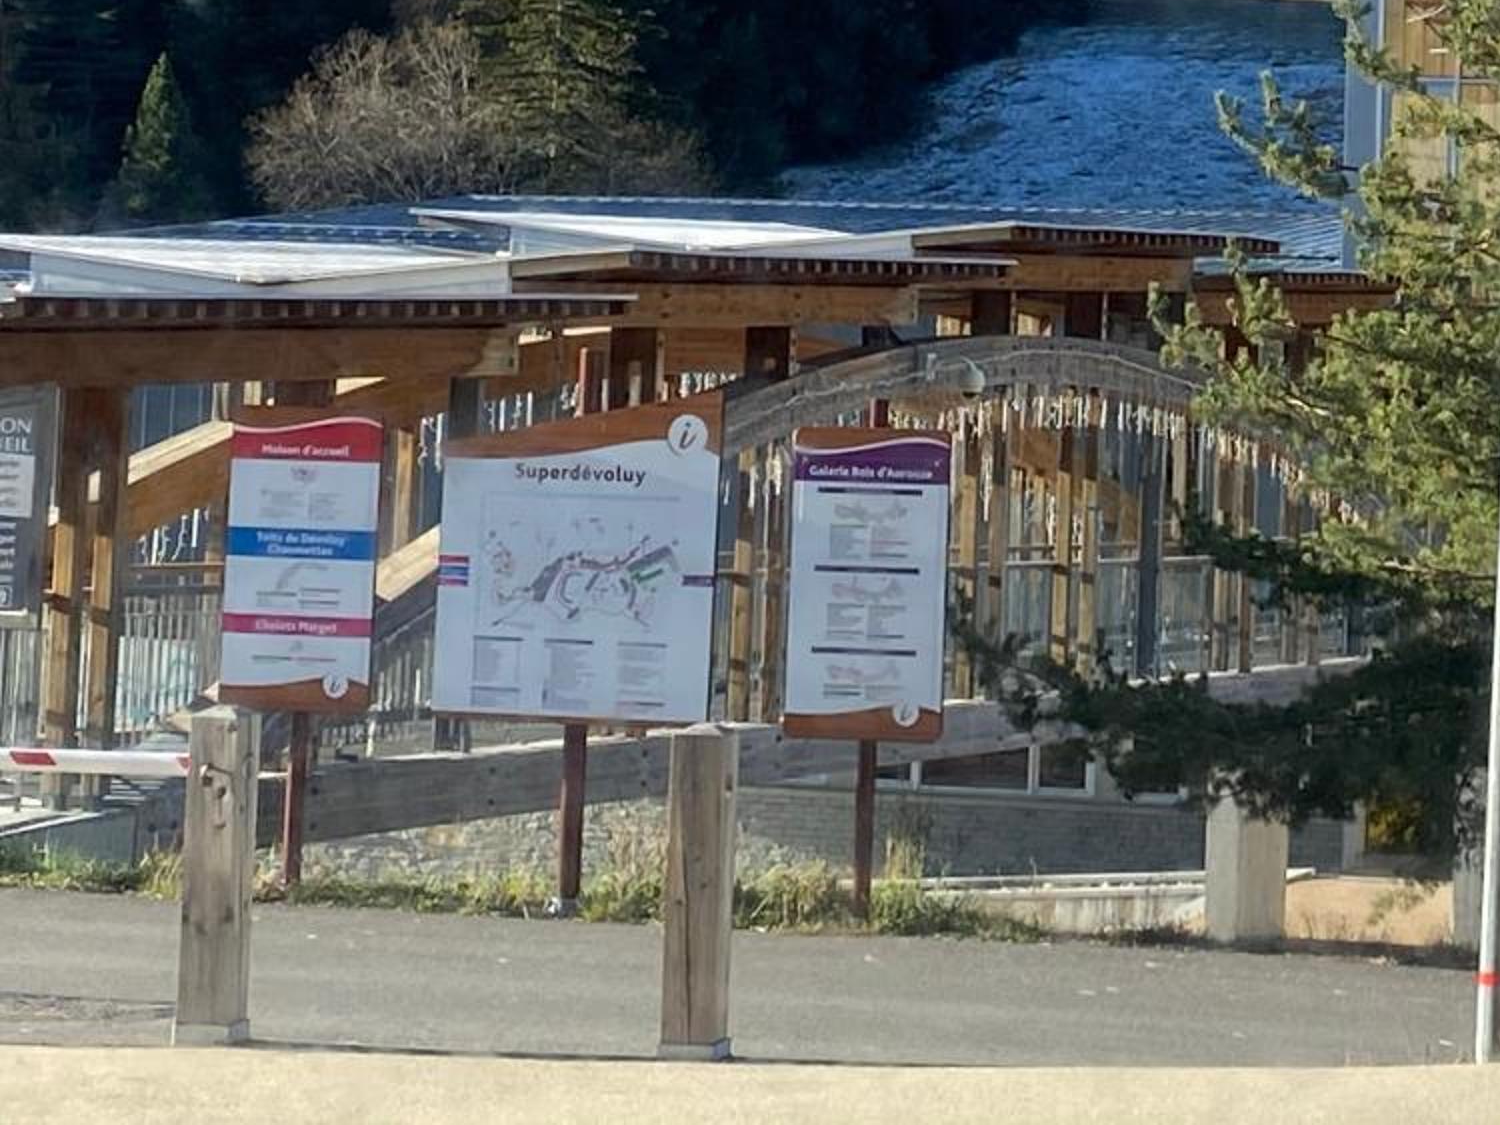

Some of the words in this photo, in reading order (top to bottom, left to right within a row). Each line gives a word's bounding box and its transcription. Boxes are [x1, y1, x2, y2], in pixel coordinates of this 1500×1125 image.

[261, 443, 299, 455] Maison
[301, 444, 350, 457] d'accueil
[515, 463, 646, 487] Superdévoluy
[809, 465, 849, 477] Galerie
[852, 466, 875, 478] Bois
